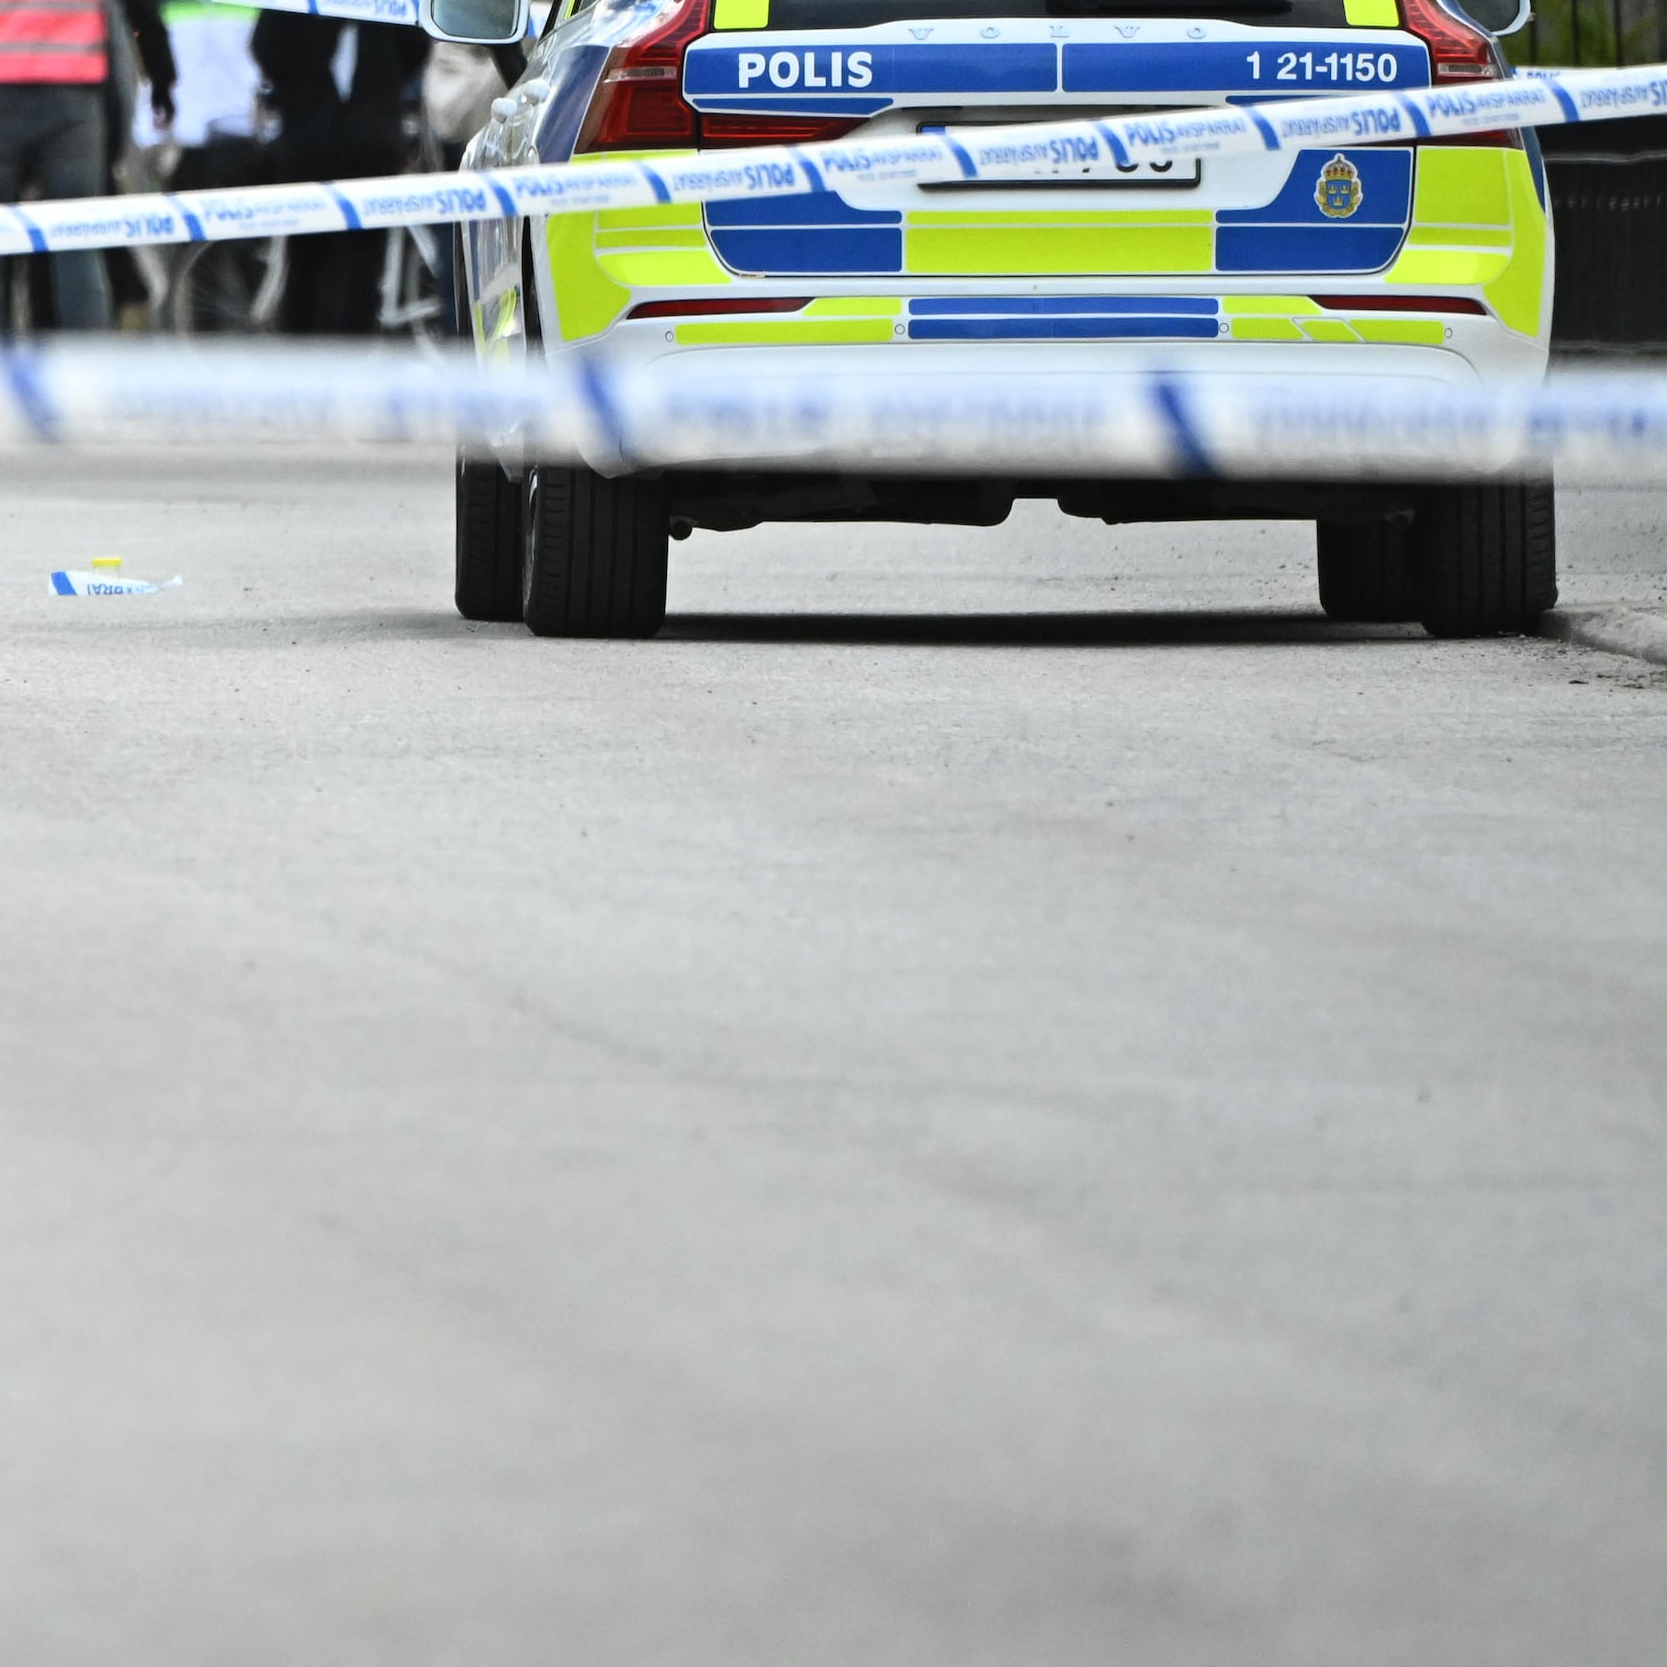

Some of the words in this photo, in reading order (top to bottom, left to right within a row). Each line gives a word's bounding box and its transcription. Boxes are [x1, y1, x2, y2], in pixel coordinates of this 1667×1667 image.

[908, 26, 1207, 40] VOLVO
[738, 51, 873, 89] POLIS
[1246, 51, 1261, 80] 1
[1276, 52, 1398, 83] 21-1150
[1429, 92, 1476, 119] POLIS
[1351, 106, 1402, 136] POLIS
[1127, 121, 1176, 150] POLIS
[821, 148, 872, 175] POLIS
[1050, 136, 1099, 164] POLIS
[744, 162, 796, 191] POLIS
[436, 188, 489, 215] POLIS
[125, 214, 175, 239] POLIS
